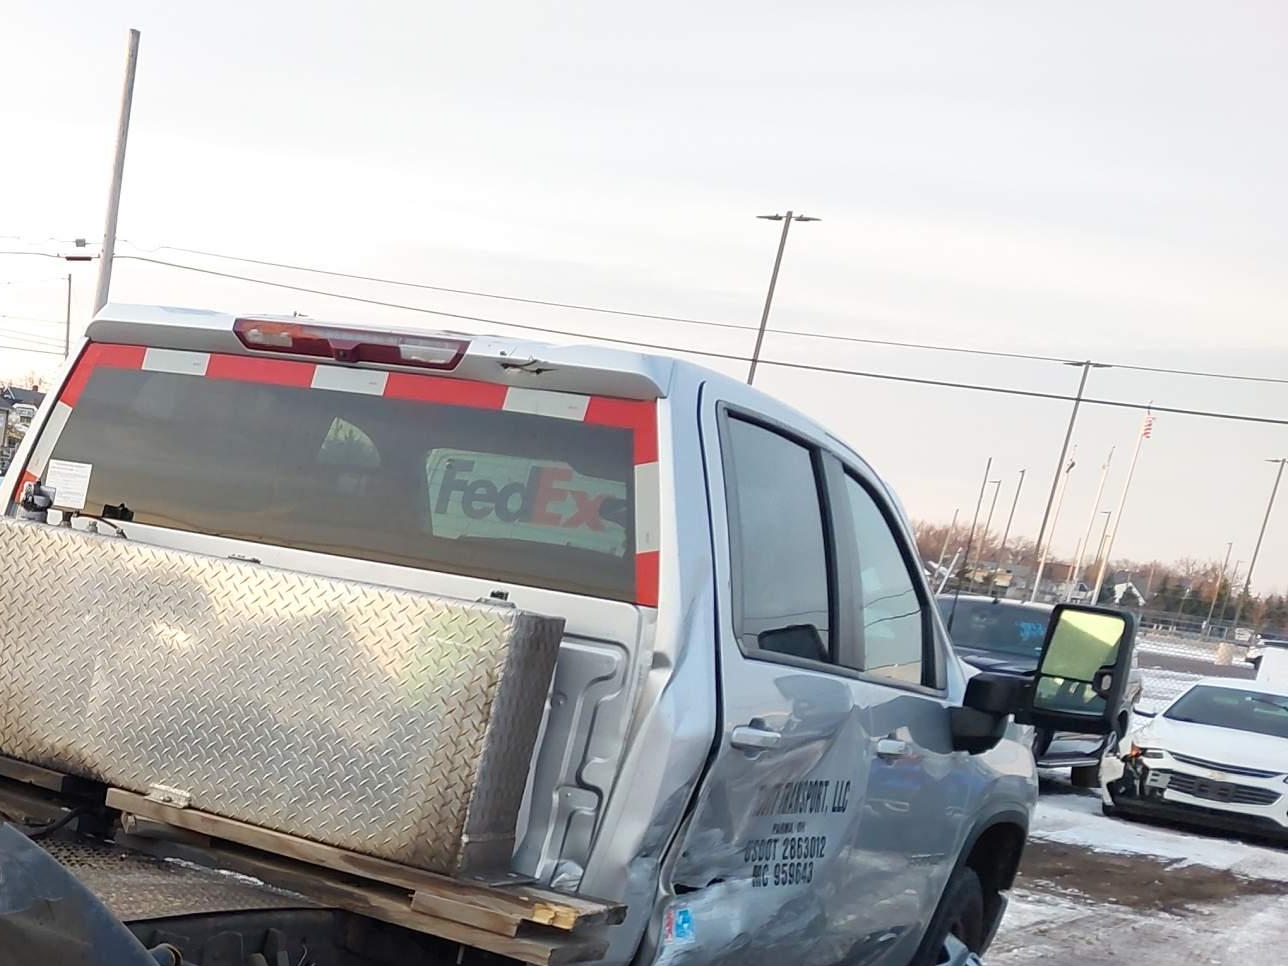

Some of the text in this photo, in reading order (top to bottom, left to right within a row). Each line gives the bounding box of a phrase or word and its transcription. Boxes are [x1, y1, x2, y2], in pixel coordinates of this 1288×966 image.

[435, 458, 617, 532] FedEx
[831, 780, 851, 813] LLC
[744, 836, 827, 862] USDOT 2863012
